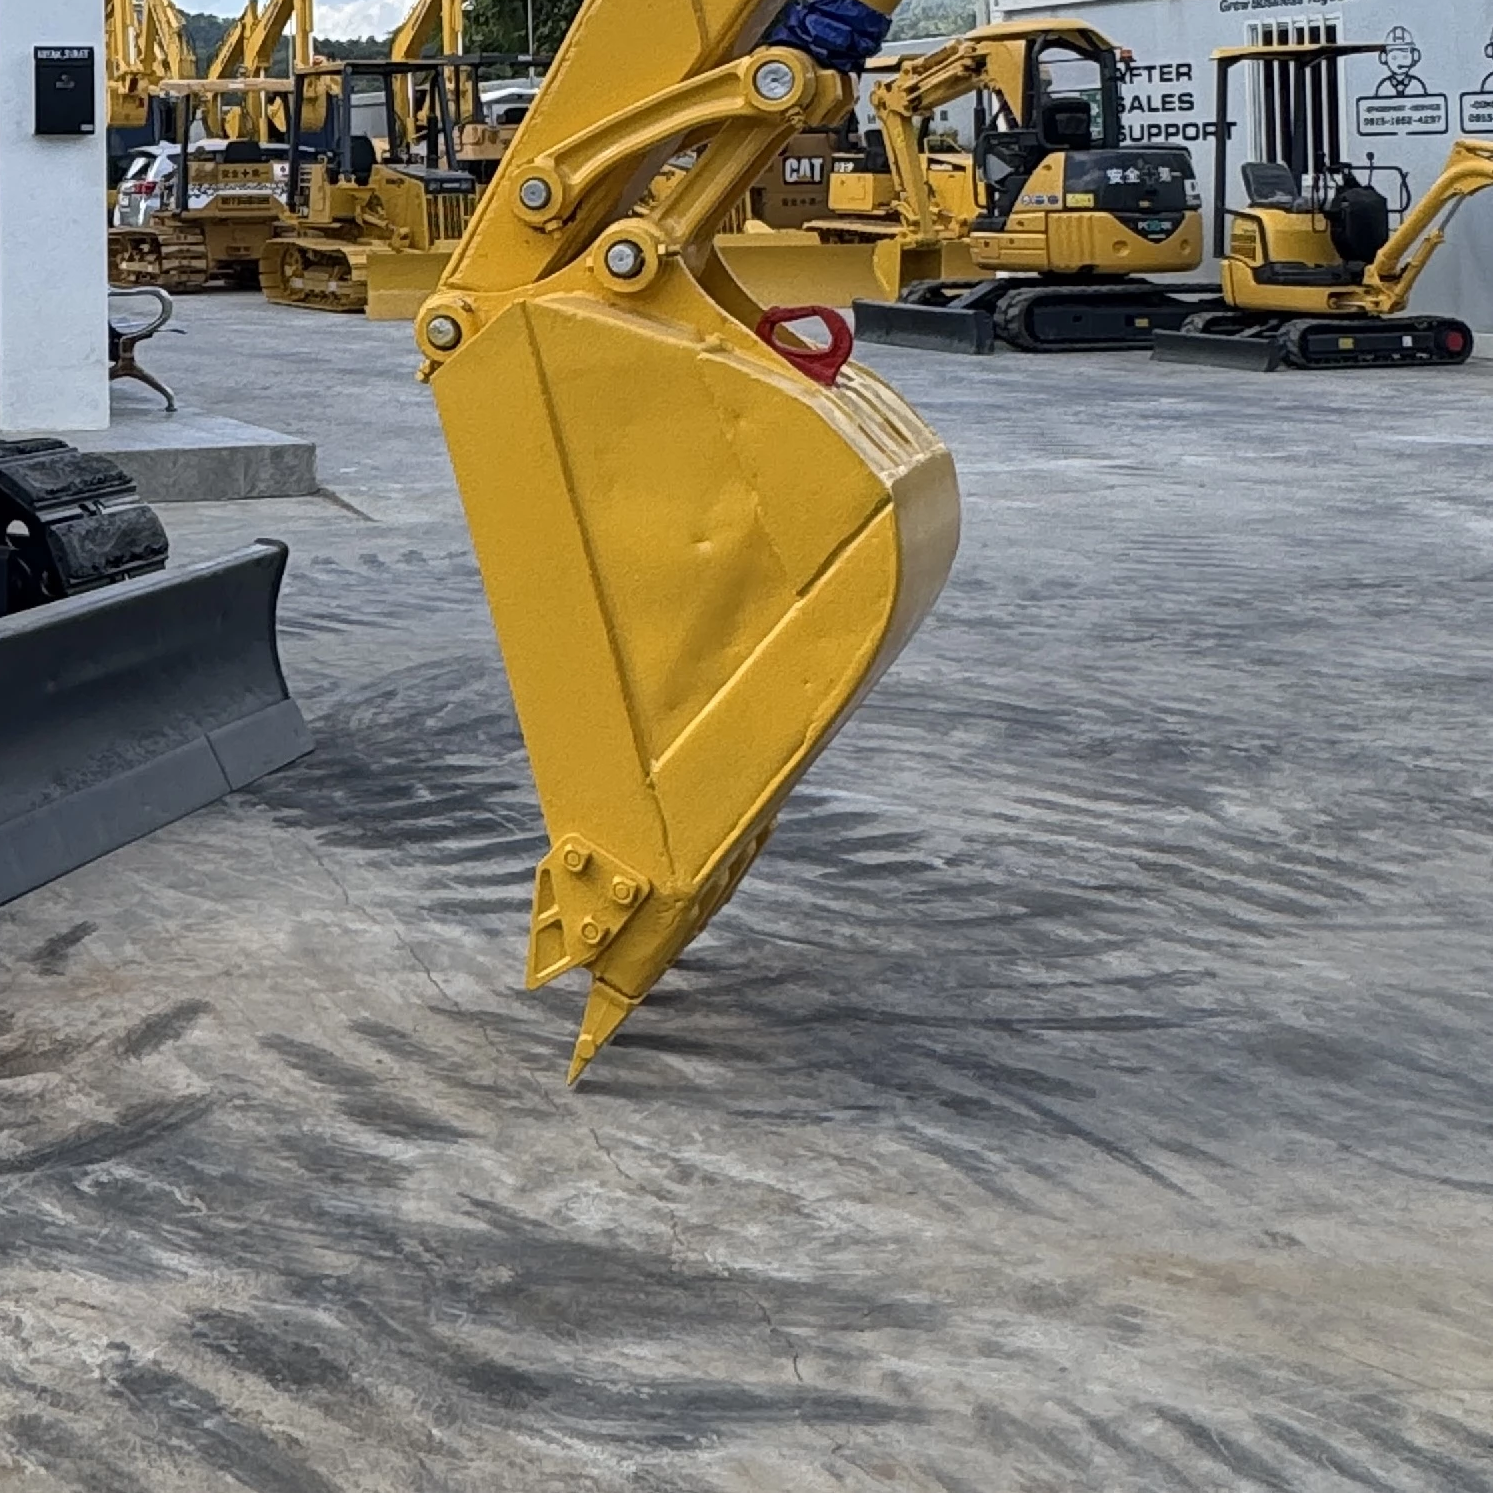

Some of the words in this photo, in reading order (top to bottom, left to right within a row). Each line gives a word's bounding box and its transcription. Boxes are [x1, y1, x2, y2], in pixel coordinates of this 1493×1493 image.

[1112, 63, 1192, 84] AFTER
[1116, 92, 1195, 114] SALES
[1117, 121, 1237, 142] SUPPORT
[784, 158, 823, 183] CAT
